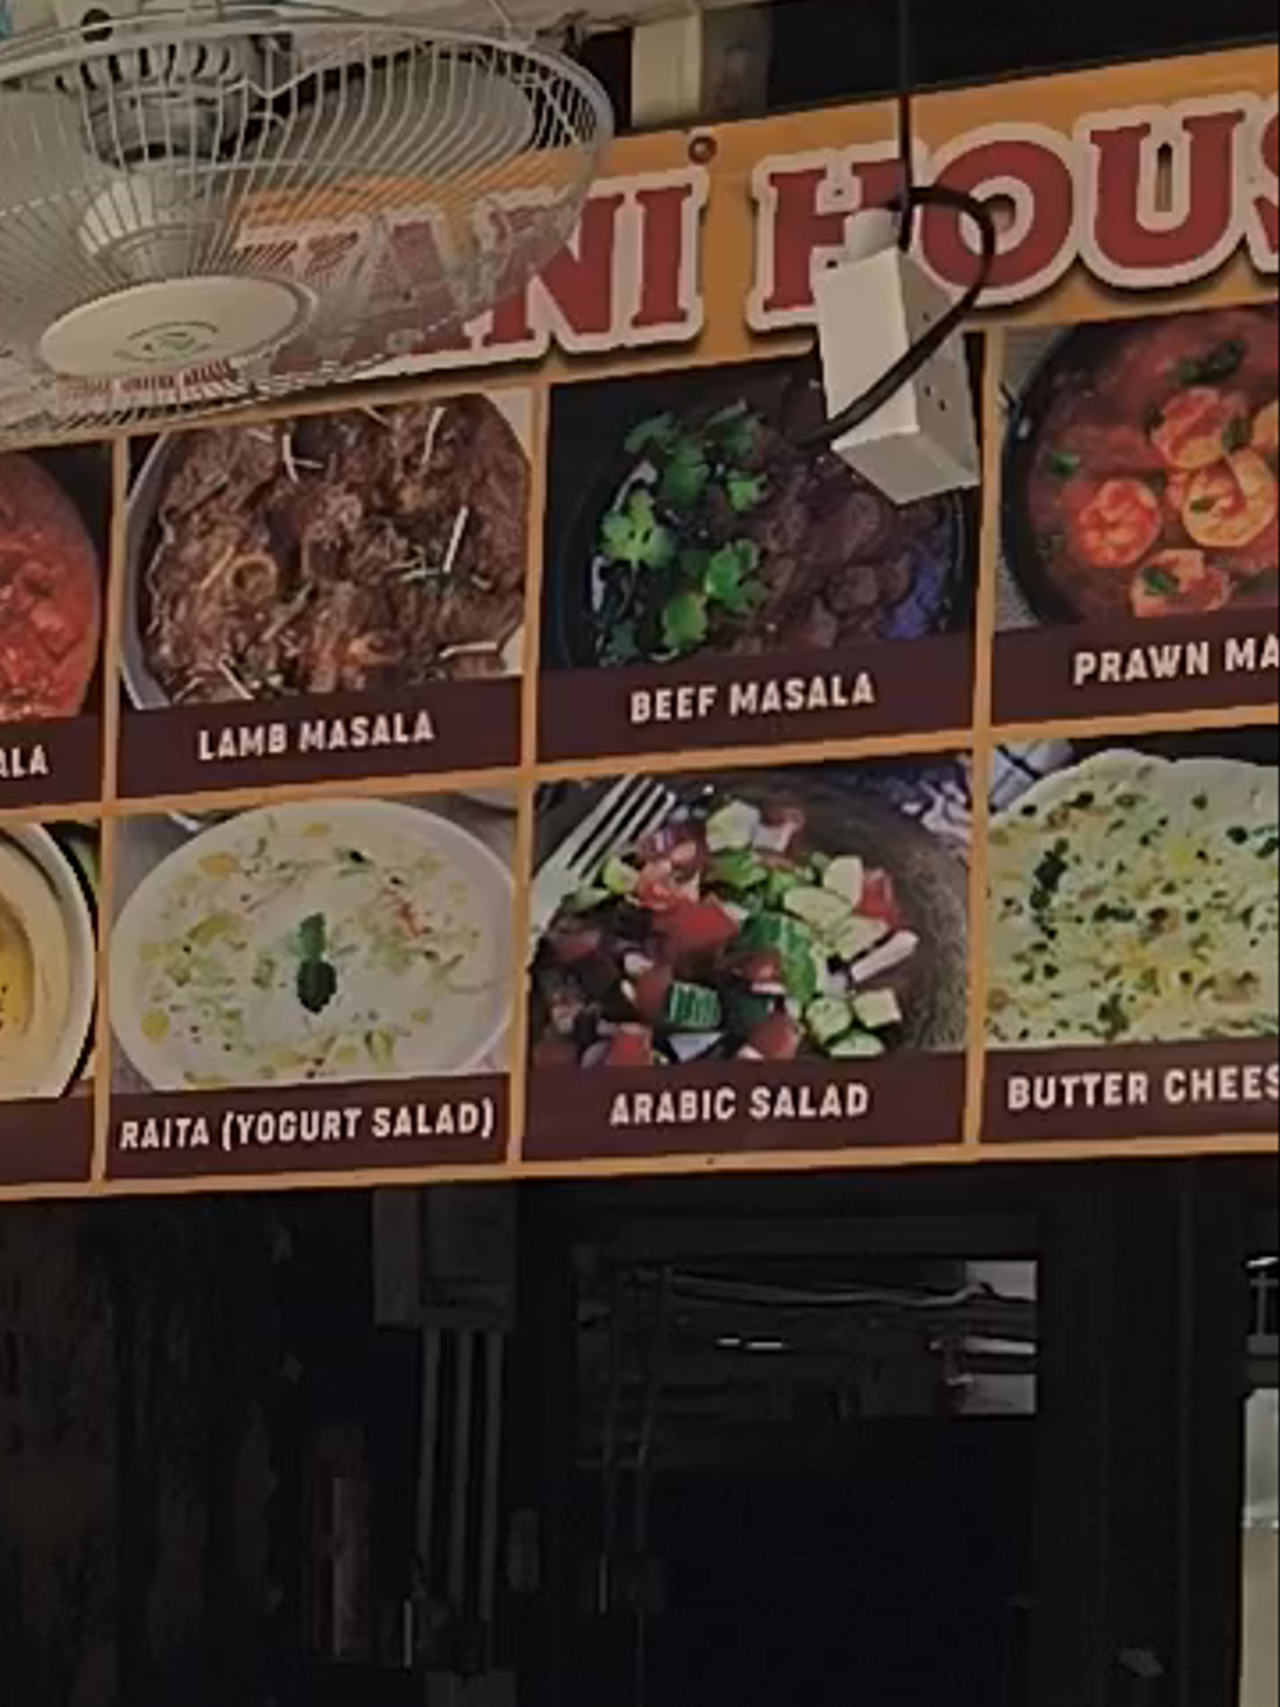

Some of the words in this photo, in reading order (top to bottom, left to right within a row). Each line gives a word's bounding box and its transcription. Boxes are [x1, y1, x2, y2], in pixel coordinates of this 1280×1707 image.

[1074, 641, 1208, 685] PRAWN
[630, 686, 716, 723] BEEF
[729, 673, 874, 714] MASALA
[199, 723, 286, 760] LAMB
[298, 710, 435, 751] MASALA
[609, 1089, 736, 1127] ARABIC
[749, 1083, 869, 1122] SALAD
[1007, 1072, 1147, 1111] BUTTER
[119, 1118, 209, 1149] RAITA
[221, 1107, 362, 1151] (YOGURT
[372, 1097, 494, 1139] SALAD)
